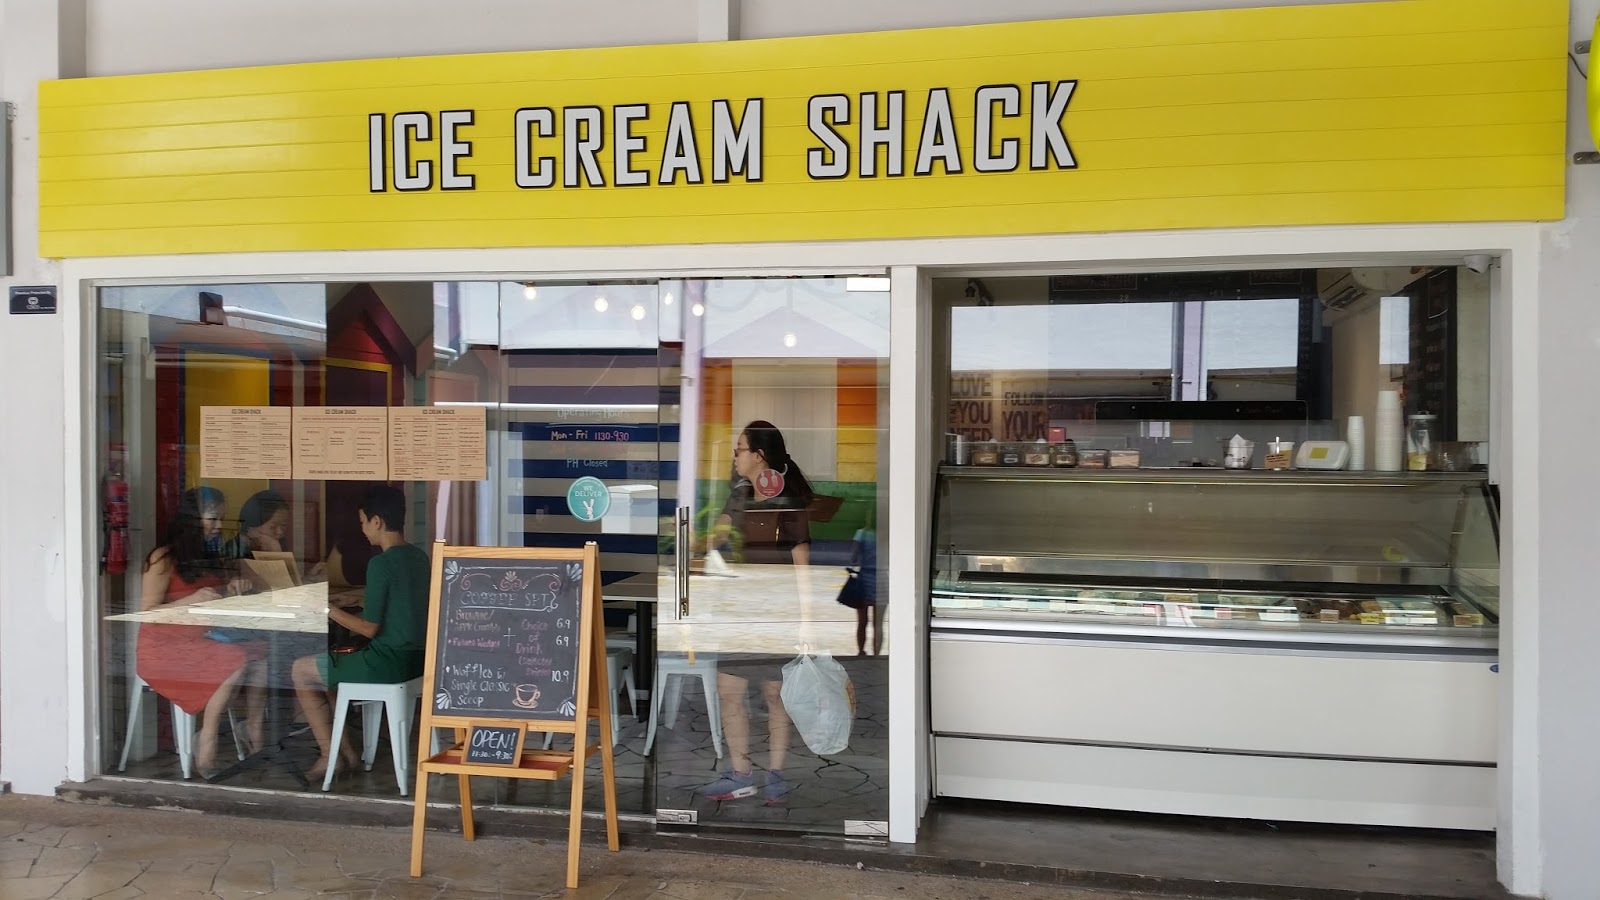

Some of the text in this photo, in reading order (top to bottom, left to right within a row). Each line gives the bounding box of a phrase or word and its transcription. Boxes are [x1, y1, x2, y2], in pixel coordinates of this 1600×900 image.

[368, 79, 1078, 192] ICE CREAM SHACK
[956, 401, 992, 425] YOU
[1002, 410, 1048, 440] YOUR
[551, 430, 568, 440] Mon
[575, 429, 588, 440] Fri
[566, 459, 579, 469] PH
[556, 617, 571, 629] 6.9
[555, 635, 570, 647] 6.9
[452, 663, 493, 679] Waffles
[551, 670, 570, 684] 10.9
[451, 678, 477, 696] Single
[457, 694, 484, 708] Scoop
[472, 729, 516, 750] OPEN!
